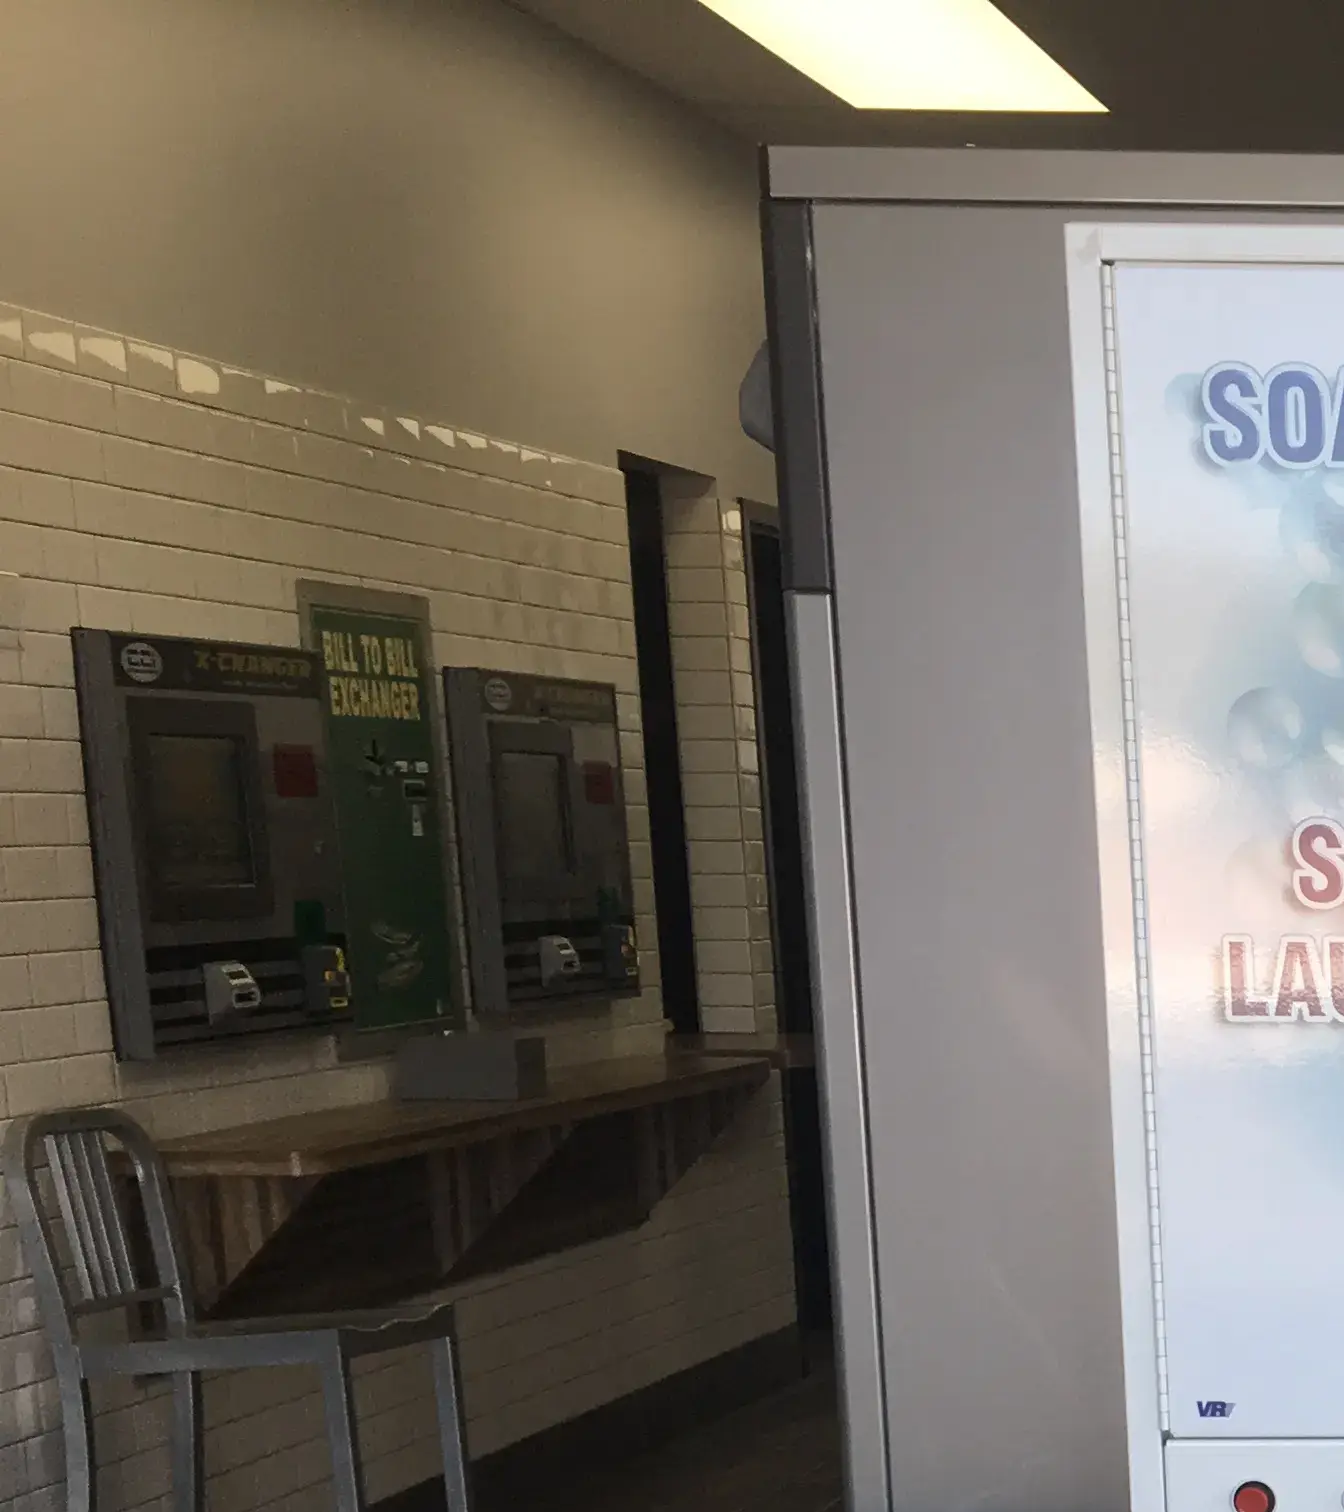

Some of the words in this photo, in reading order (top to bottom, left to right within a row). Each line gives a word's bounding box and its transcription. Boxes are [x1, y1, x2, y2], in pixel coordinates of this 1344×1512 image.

[321, 630, 358, 672] BILL
[360, 634, 382, 674] TO
[384, 637, 419, 677] BILL
[329, 676, 421, 720] EXCHANGER
